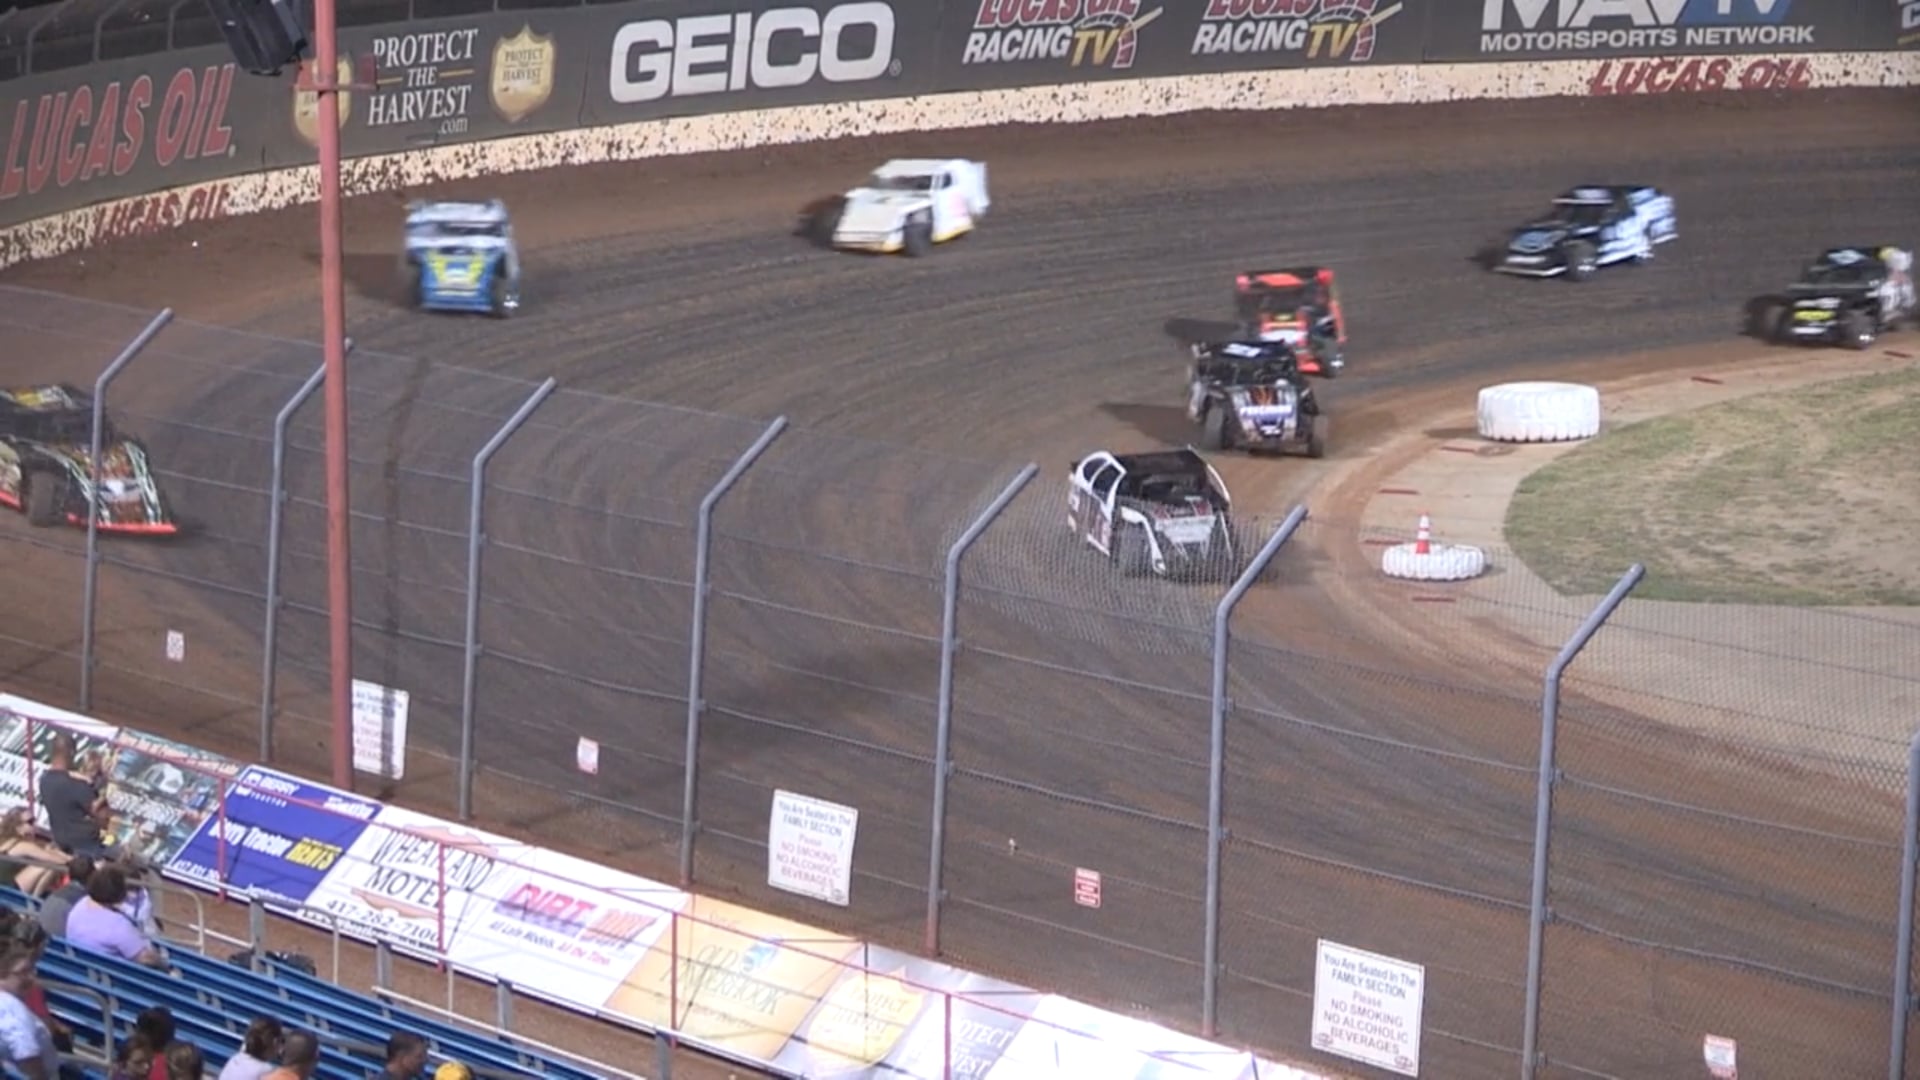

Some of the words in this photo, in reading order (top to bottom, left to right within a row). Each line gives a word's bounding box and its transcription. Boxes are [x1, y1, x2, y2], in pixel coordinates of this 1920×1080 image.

[373, 28, 479, 68] PROTECT
[610, 1, 895, 103] GEICO
[962, 26, 1074, 65] RACING
[1191, 20, 1309, 54] RACING
[1481, 28, 1677, 52] MOTORSPORTS
[1686, 25, 1815, 47] NETWORK
[406, 66, 437, 88] THE
[1589, 57, 1732, 95] LUCAS
[1738, 56, 1812, 90] OIL
[367, 85, 472, 126] HARVEST
[0, 74, 153, 200] LUCAS
[156, 63, 235, 167] OIL
[208, 817, 248, 846] Brry
[1323, 953, 1340, 967] You
[1341, 957, 1356, 971] Are
[1358, 961, 1388, 981] Seated
[1400, 972, 1417, 988] The
[1331, 967, 1363, 987] FAMILY
[1365, 977, 1407, 999] SECTION
[1331, 998, 1347, 1013] NO
[1349, 1003, 1404, 1028] SMOKING
[1353, 989, 1382, 1007] Please
[1323, 1010, 1340, 1024] NO
[1341, 1016, 1409, 1045] ALCOHOLIC
[1330, 1026, 1400, 1056] BEVERAGES
